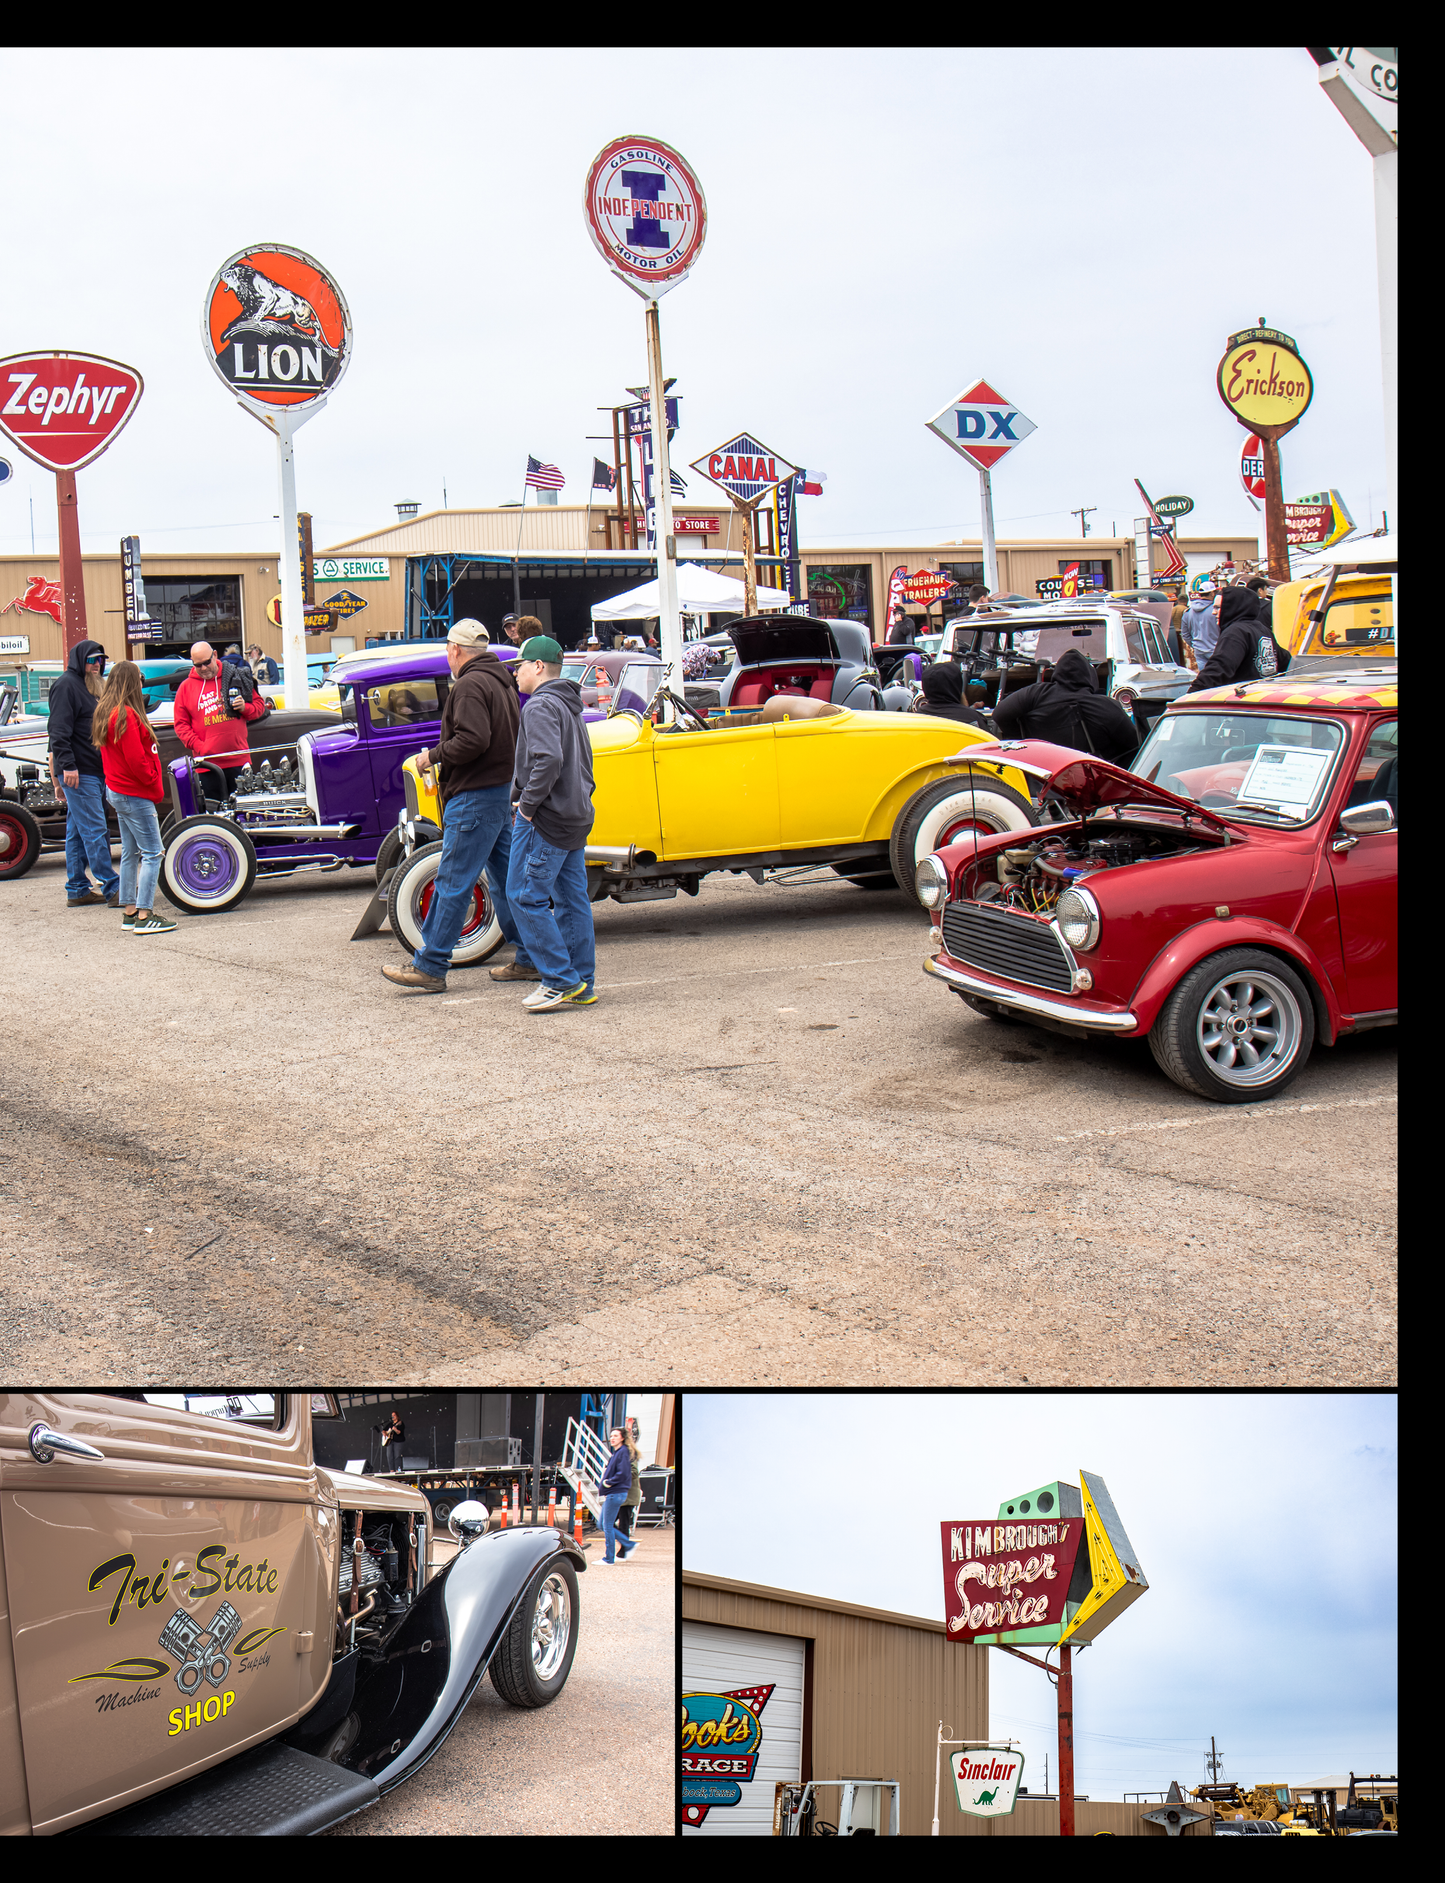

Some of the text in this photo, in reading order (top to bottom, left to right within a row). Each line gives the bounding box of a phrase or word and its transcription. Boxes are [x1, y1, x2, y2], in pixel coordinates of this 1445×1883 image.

[610, 150, 674, 173] GASOLINE
[598, 196, 692, 222] INDEPENDENT
[614, 243, 685, 268] MOTOR OIL
[233, 343, 324, 382] LION
[1227, 349, 1305, 403] Erickson
[1, 373, 127, 426] Zephyr
[954, 409, 1020, 441] DX
[708, 453, 779, 482] CANAL
[1243, 460, 1264, 476] DER
[1155, 501, 1188, 513] HOLIDAY
[685, 520, 710, 530] STORE
[1285, 517, 1322, 532] uper
[1286, 529, 1320, 544] ervice
[778, 484, 791, 592] CHEVROET
[342, 561, 384, 575] SERVICE
[123, 541, 135, 621] LUMBER
[903, 574, 946, 588] FRUEHAUF
[903, 587, 946, 600] TRAILERS
[1039, 579, 1085, 591] COUS
[951, 1521, 1070, 1562] KIMBROUGH'S
[88, 1544, 279, 1626] Tri-State
[952, 1553, 1058, 1605] Super
[948, 1588, 1049, 1633] Service
[237, 1651, 271, 1674] Supply
[95, 1685, 161, 1713] Machine
[168, 1690, 235, 1736] SHOP
[682, 1757, 748, 1774] RAGE
[958, 1757, 1016, 1781] Sinclair
[682, 1786, 736, 1799] bock, Texas
